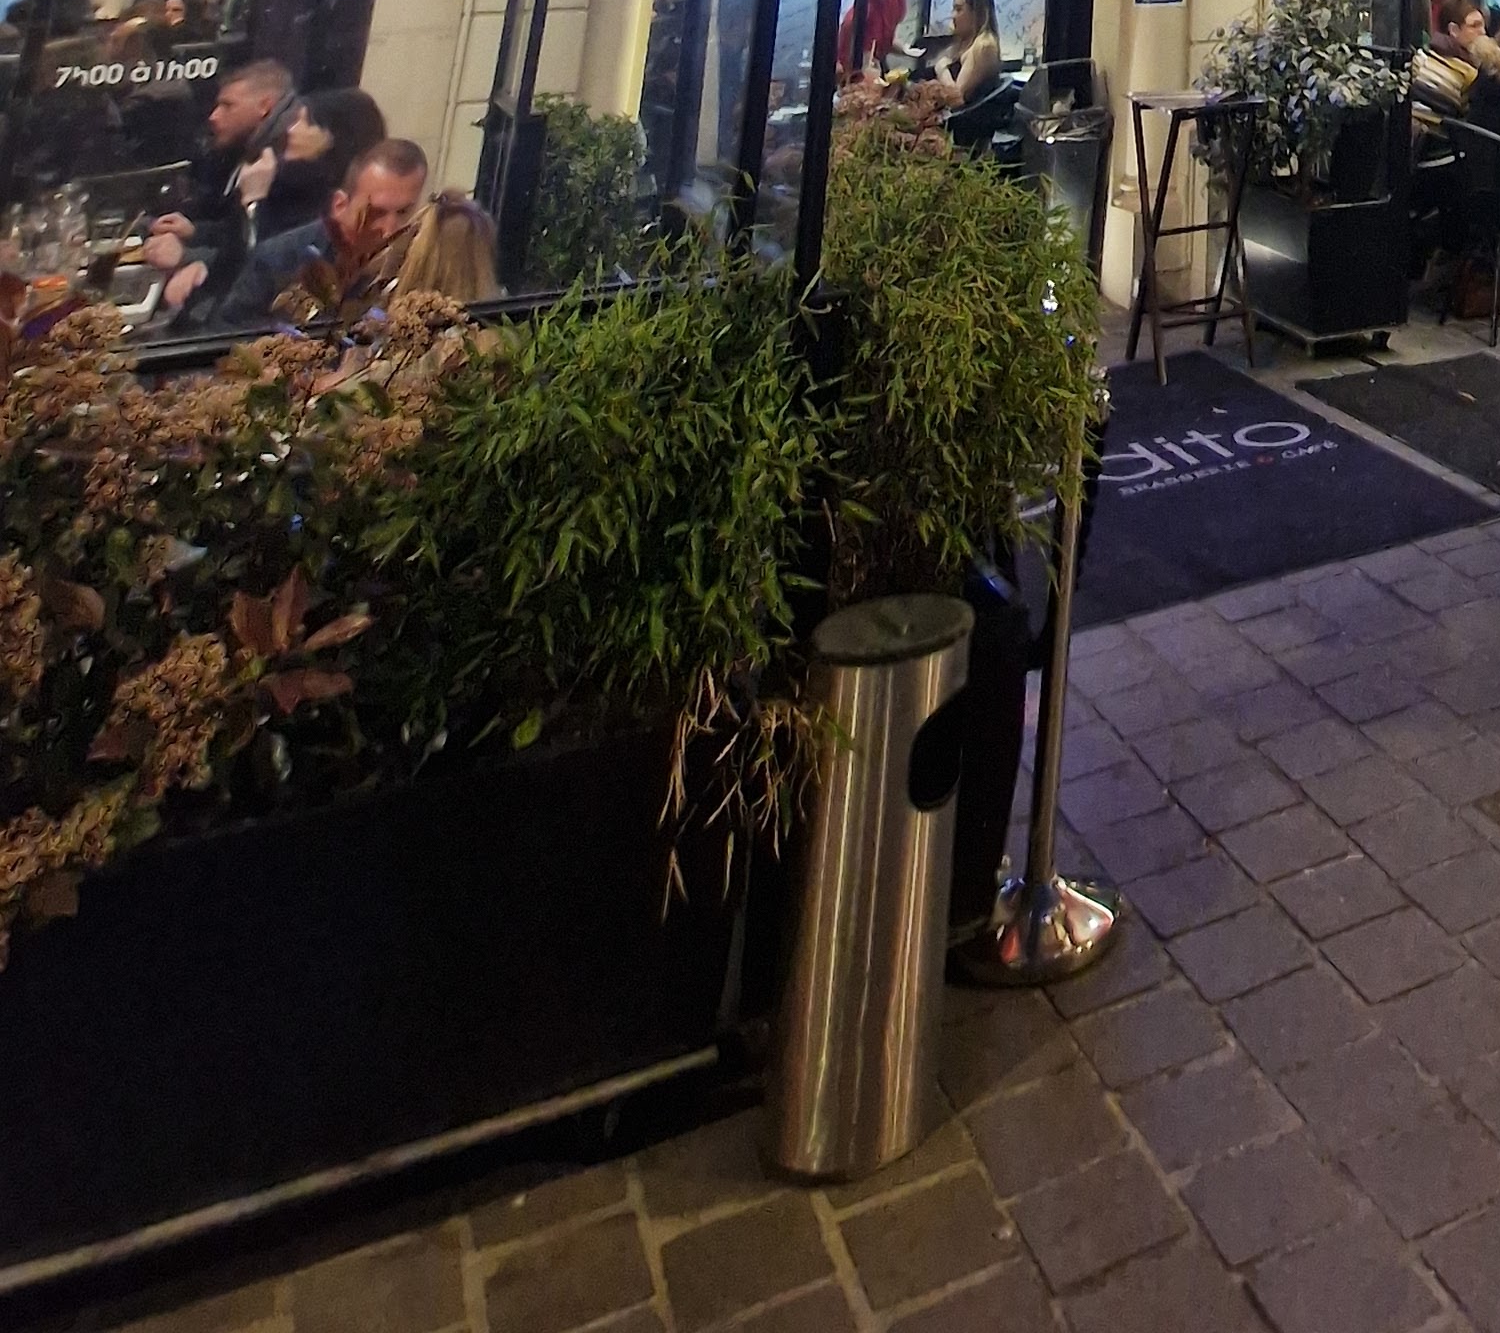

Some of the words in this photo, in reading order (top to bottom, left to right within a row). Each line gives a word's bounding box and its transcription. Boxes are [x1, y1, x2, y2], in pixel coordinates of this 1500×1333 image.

[54, 63, 125, 89] 7h00
[130, 60, 151, 83] à
[155, 57, 219, 81] 1h00
